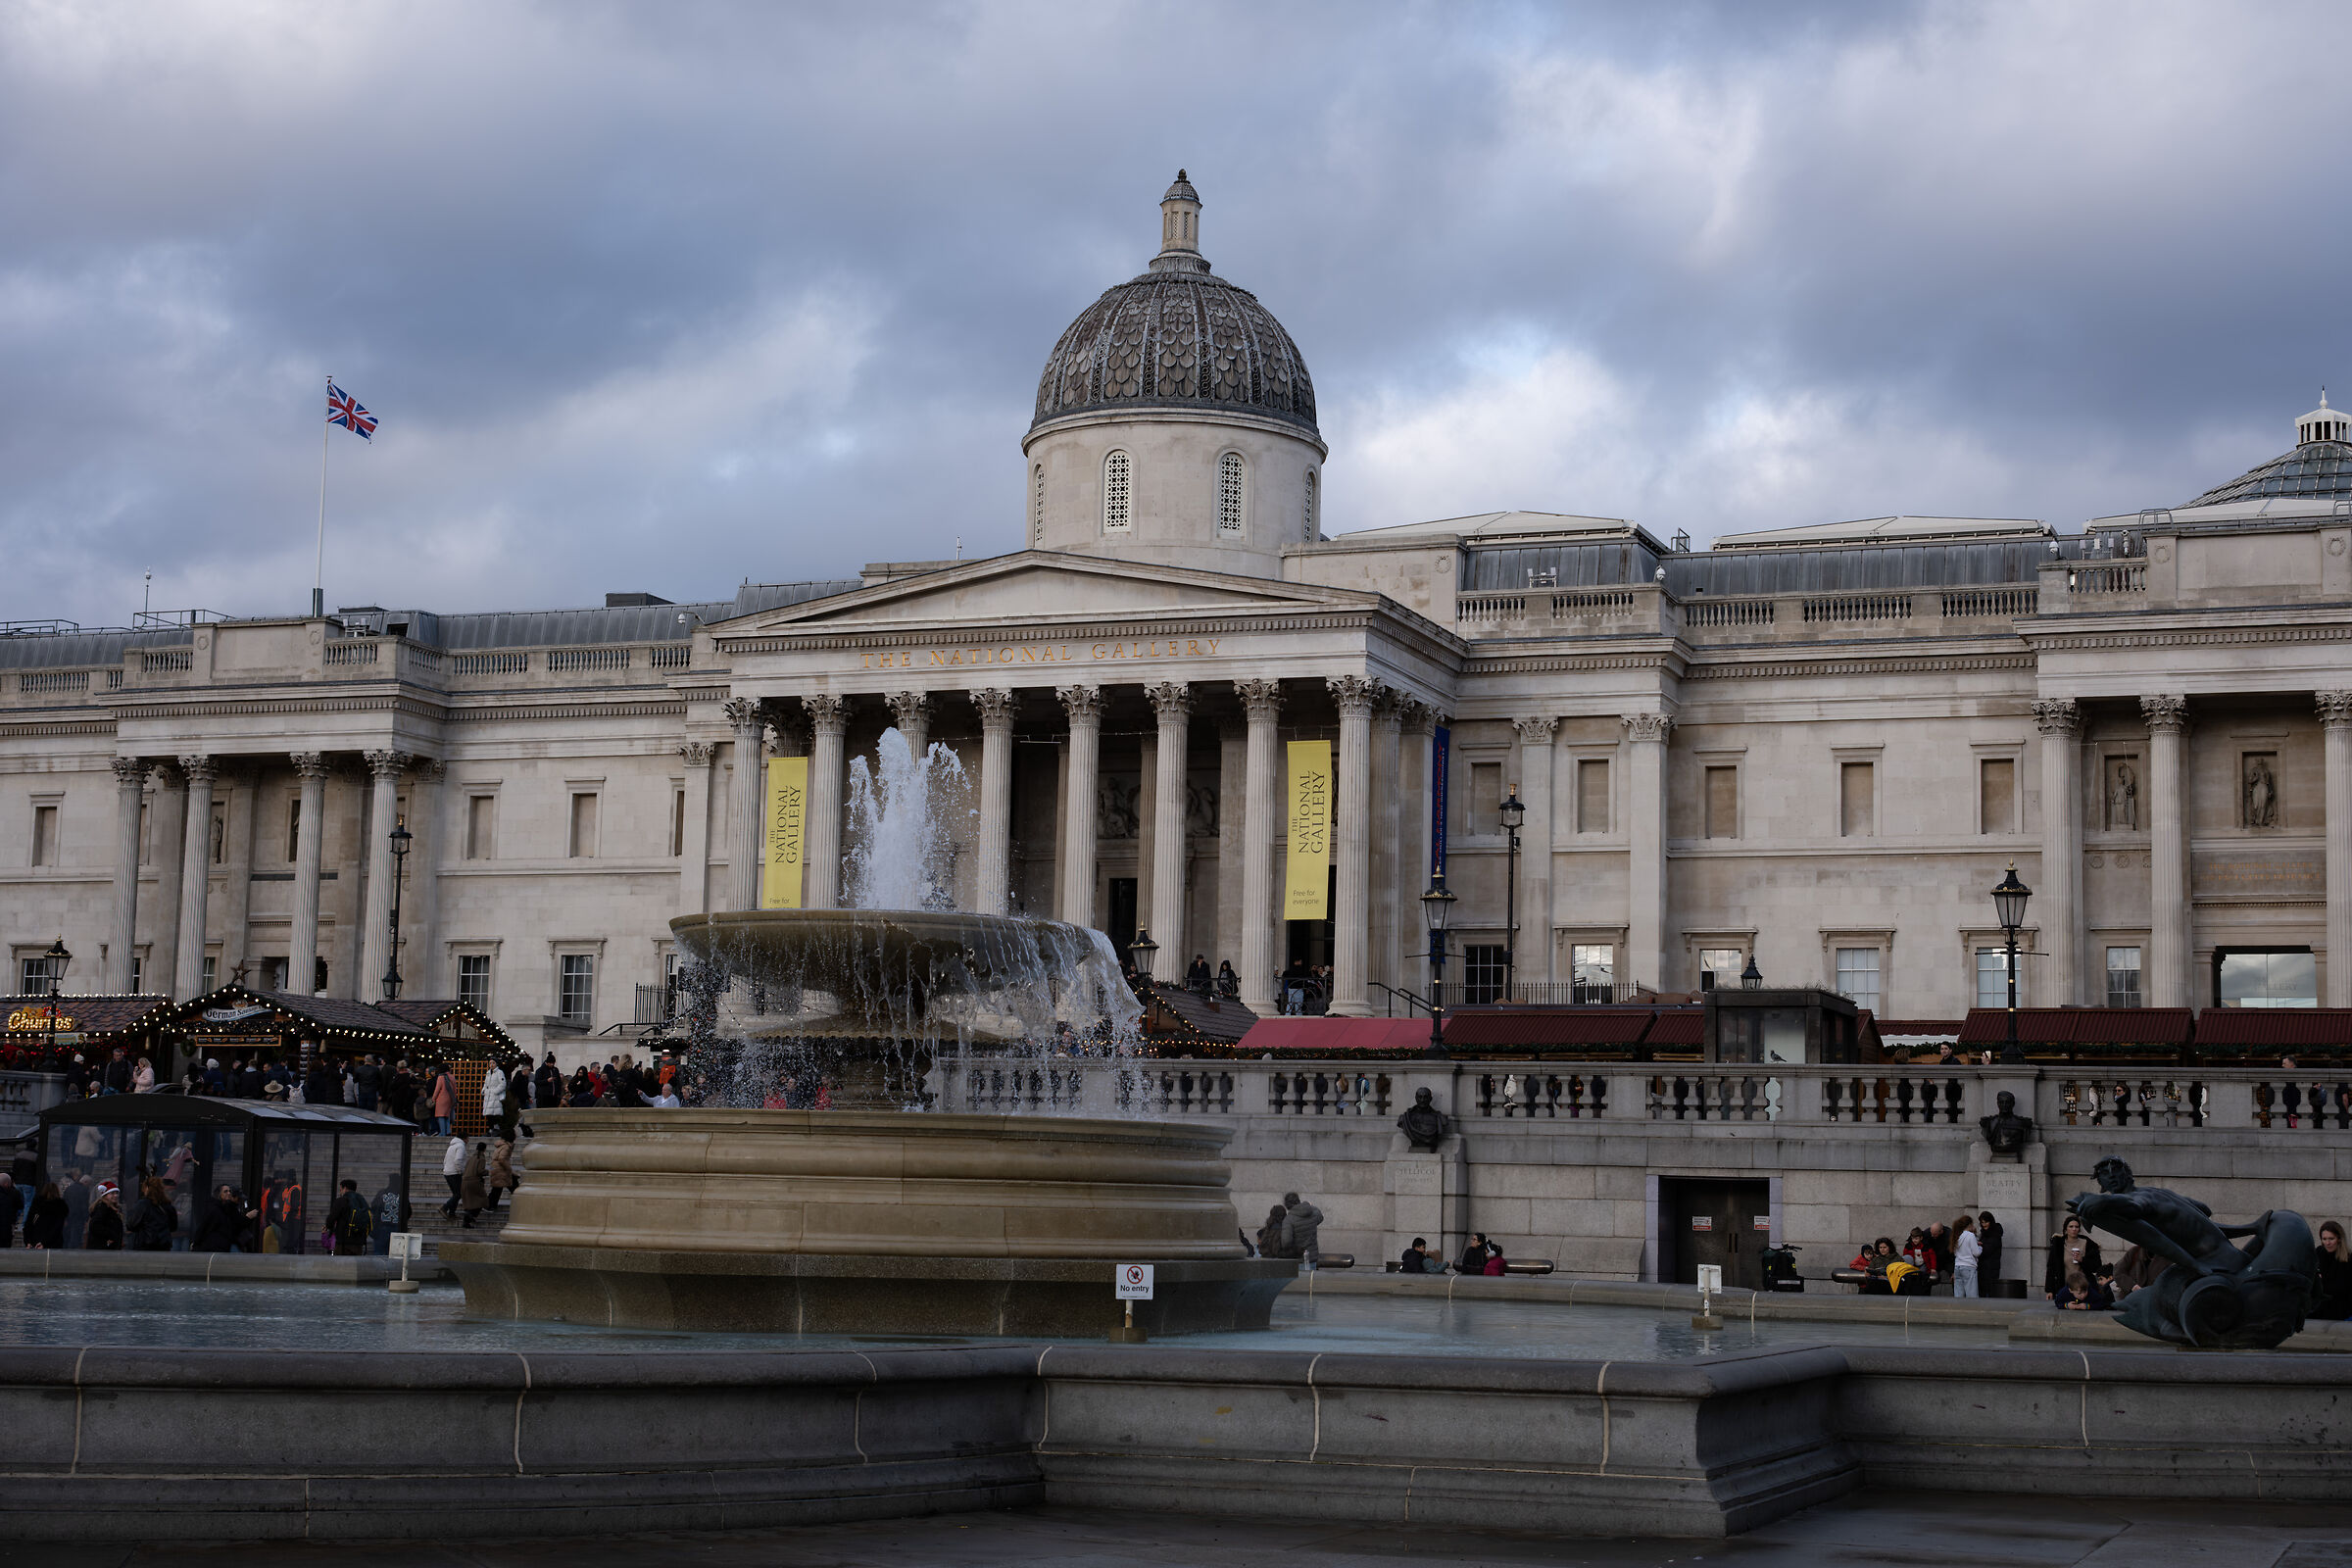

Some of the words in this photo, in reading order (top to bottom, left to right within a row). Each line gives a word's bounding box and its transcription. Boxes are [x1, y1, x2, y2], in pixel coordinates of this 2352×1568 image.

[860, 652, 911, 668] THE
[929, 645, 1073, 666] NATIONAL
[1092, 639, 1221, 660] GALLERY
[775, 785, 789, 863] NATIONAL
[786, 786, 801, 863] GALLERY
[1298, 770, 1311, 854] NATIONAL
[1310, 771, 1325, 854] GALLERY
[1293, 898, 1319, 906] everyone
[206, 1007, 236, 1019] German
[1131, 1285, 1150, 1294] entry
